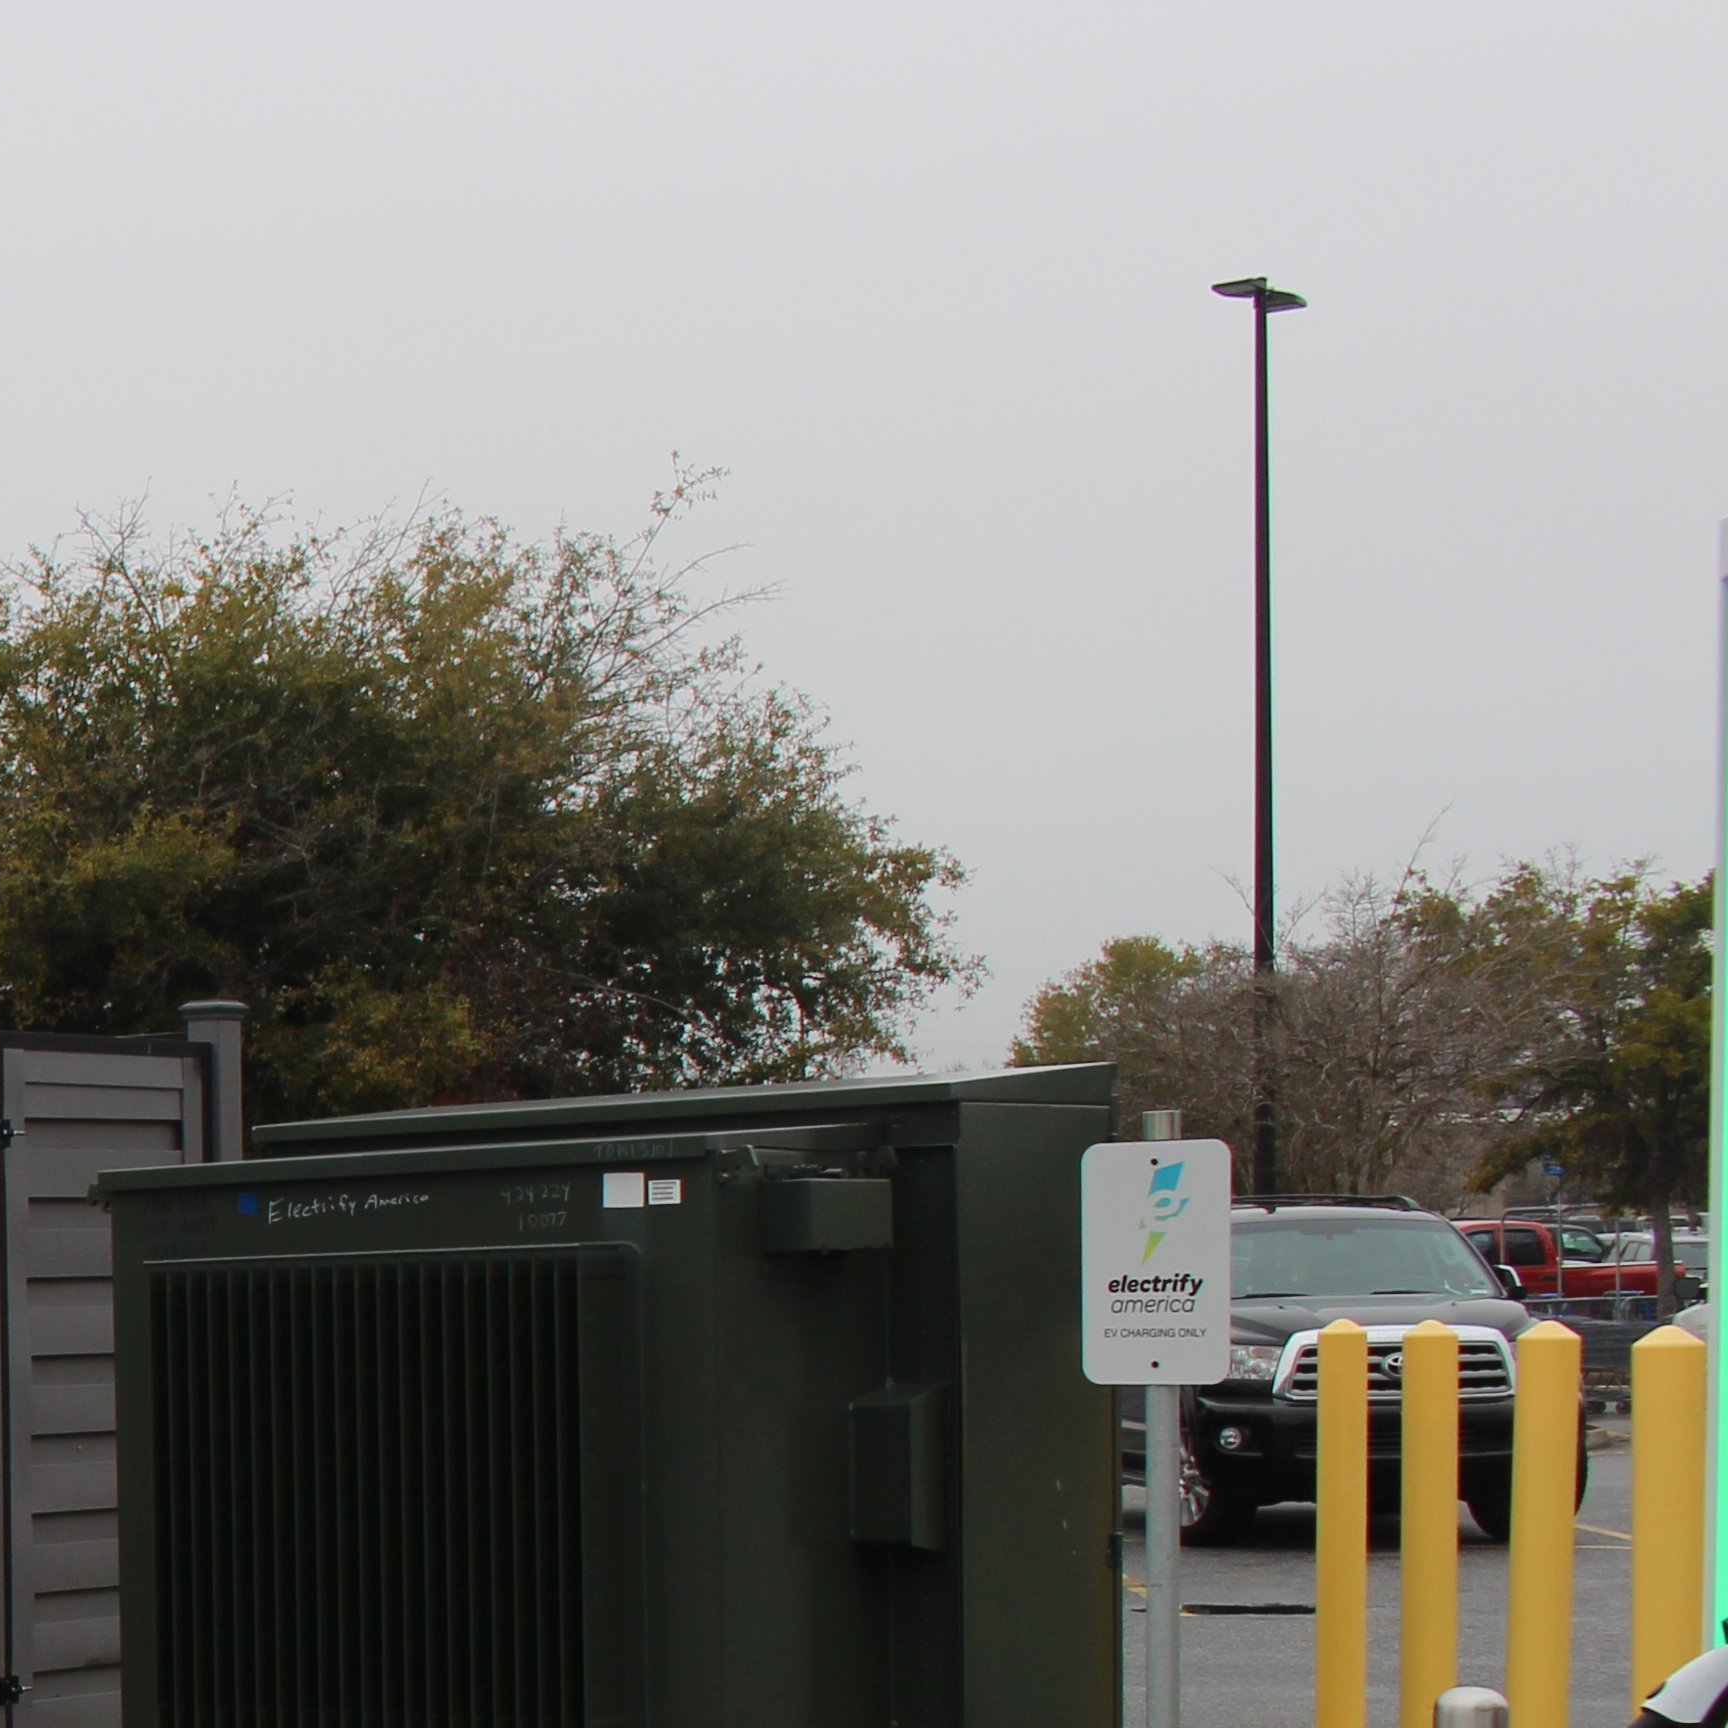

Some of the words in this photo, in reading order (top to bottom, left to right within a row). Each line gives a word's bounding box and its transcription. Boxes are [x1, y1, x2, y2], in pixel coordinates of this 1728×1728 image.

[364, 1194, 430, 1210] America
[1108, 1273, 1204, 1296] electrify
[1110, 1295, 1196, 1313] america
[1104, 1328, 1118, 1338] EV
[1120, 1328, 1175, 1338] CHARGING
[1178, 1328, 1207, 1338] ONLY
